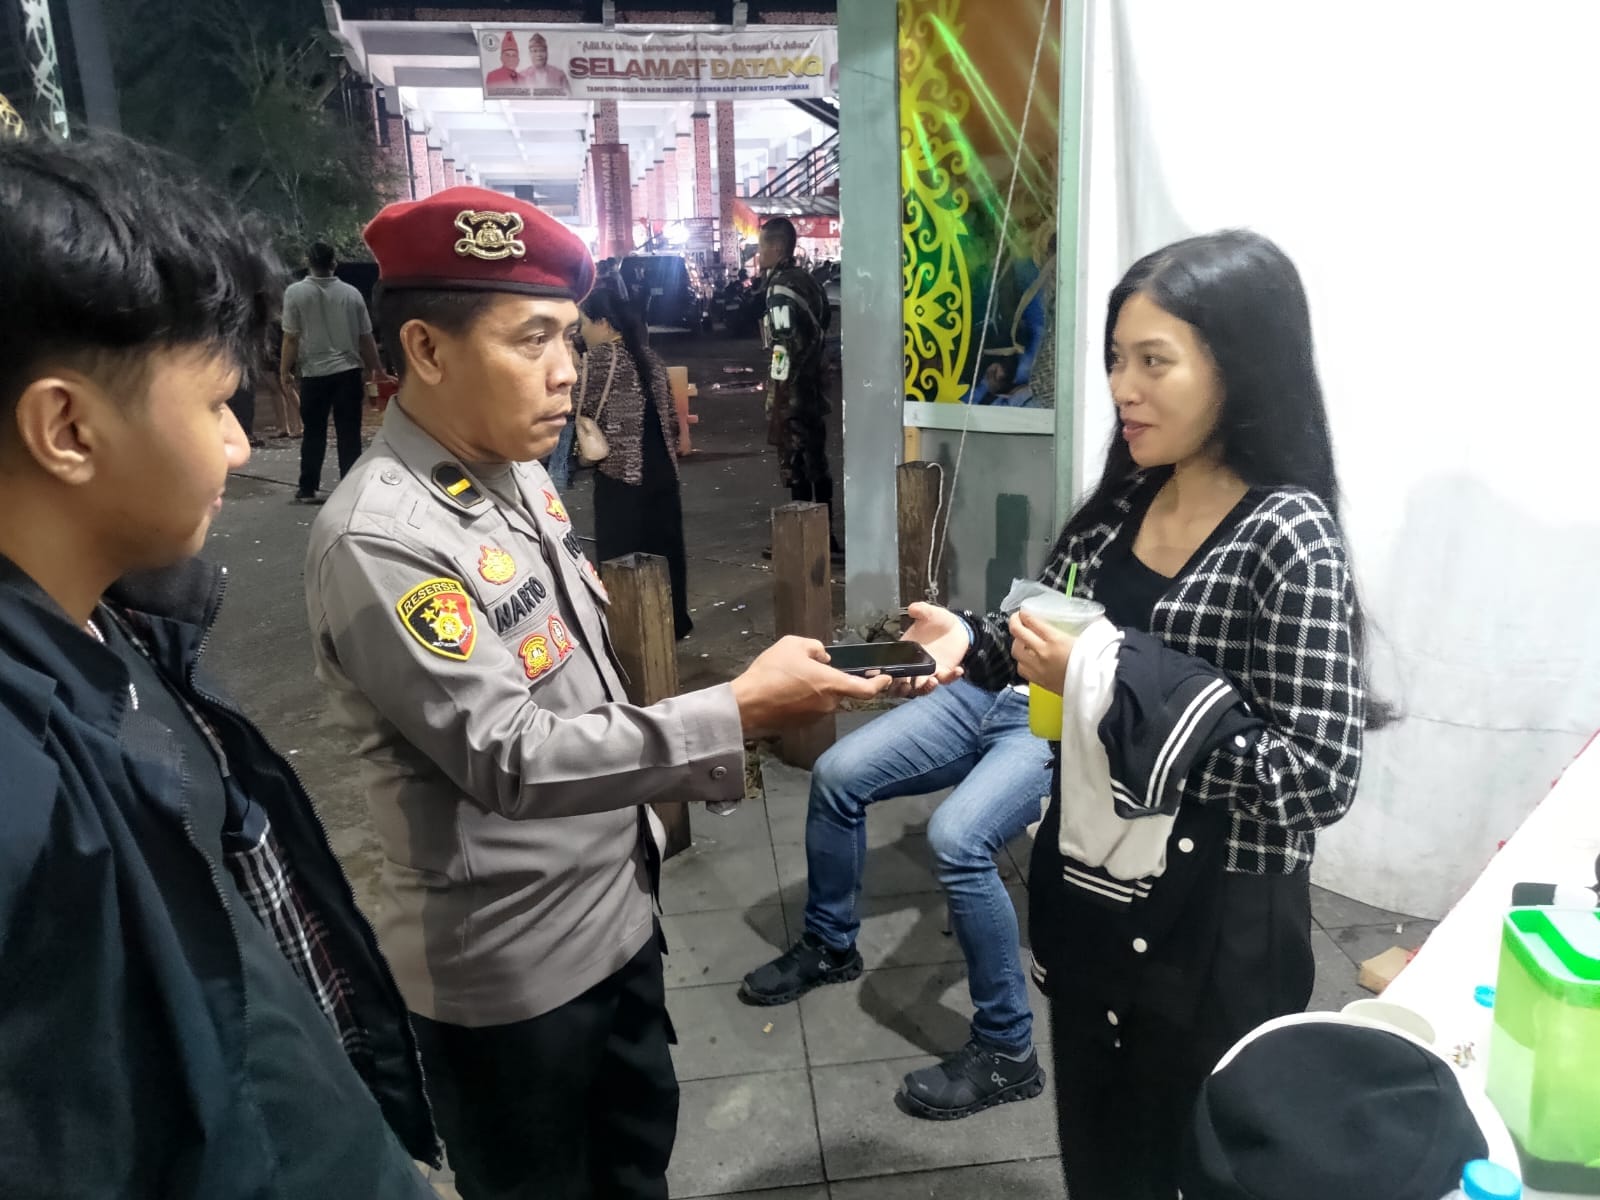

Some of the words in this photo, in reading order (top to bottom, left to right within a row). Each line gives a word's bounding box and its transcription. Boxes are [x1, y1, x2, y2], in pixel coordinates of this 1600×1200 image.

[570, 57, 707, 79] SELAMAT
[711, 55, 824, 79] DATANG
[829, 220, 840, 234] P
[403, 582, 457, 614] RESERSE
[495, 576, 546, 633] NARTO
